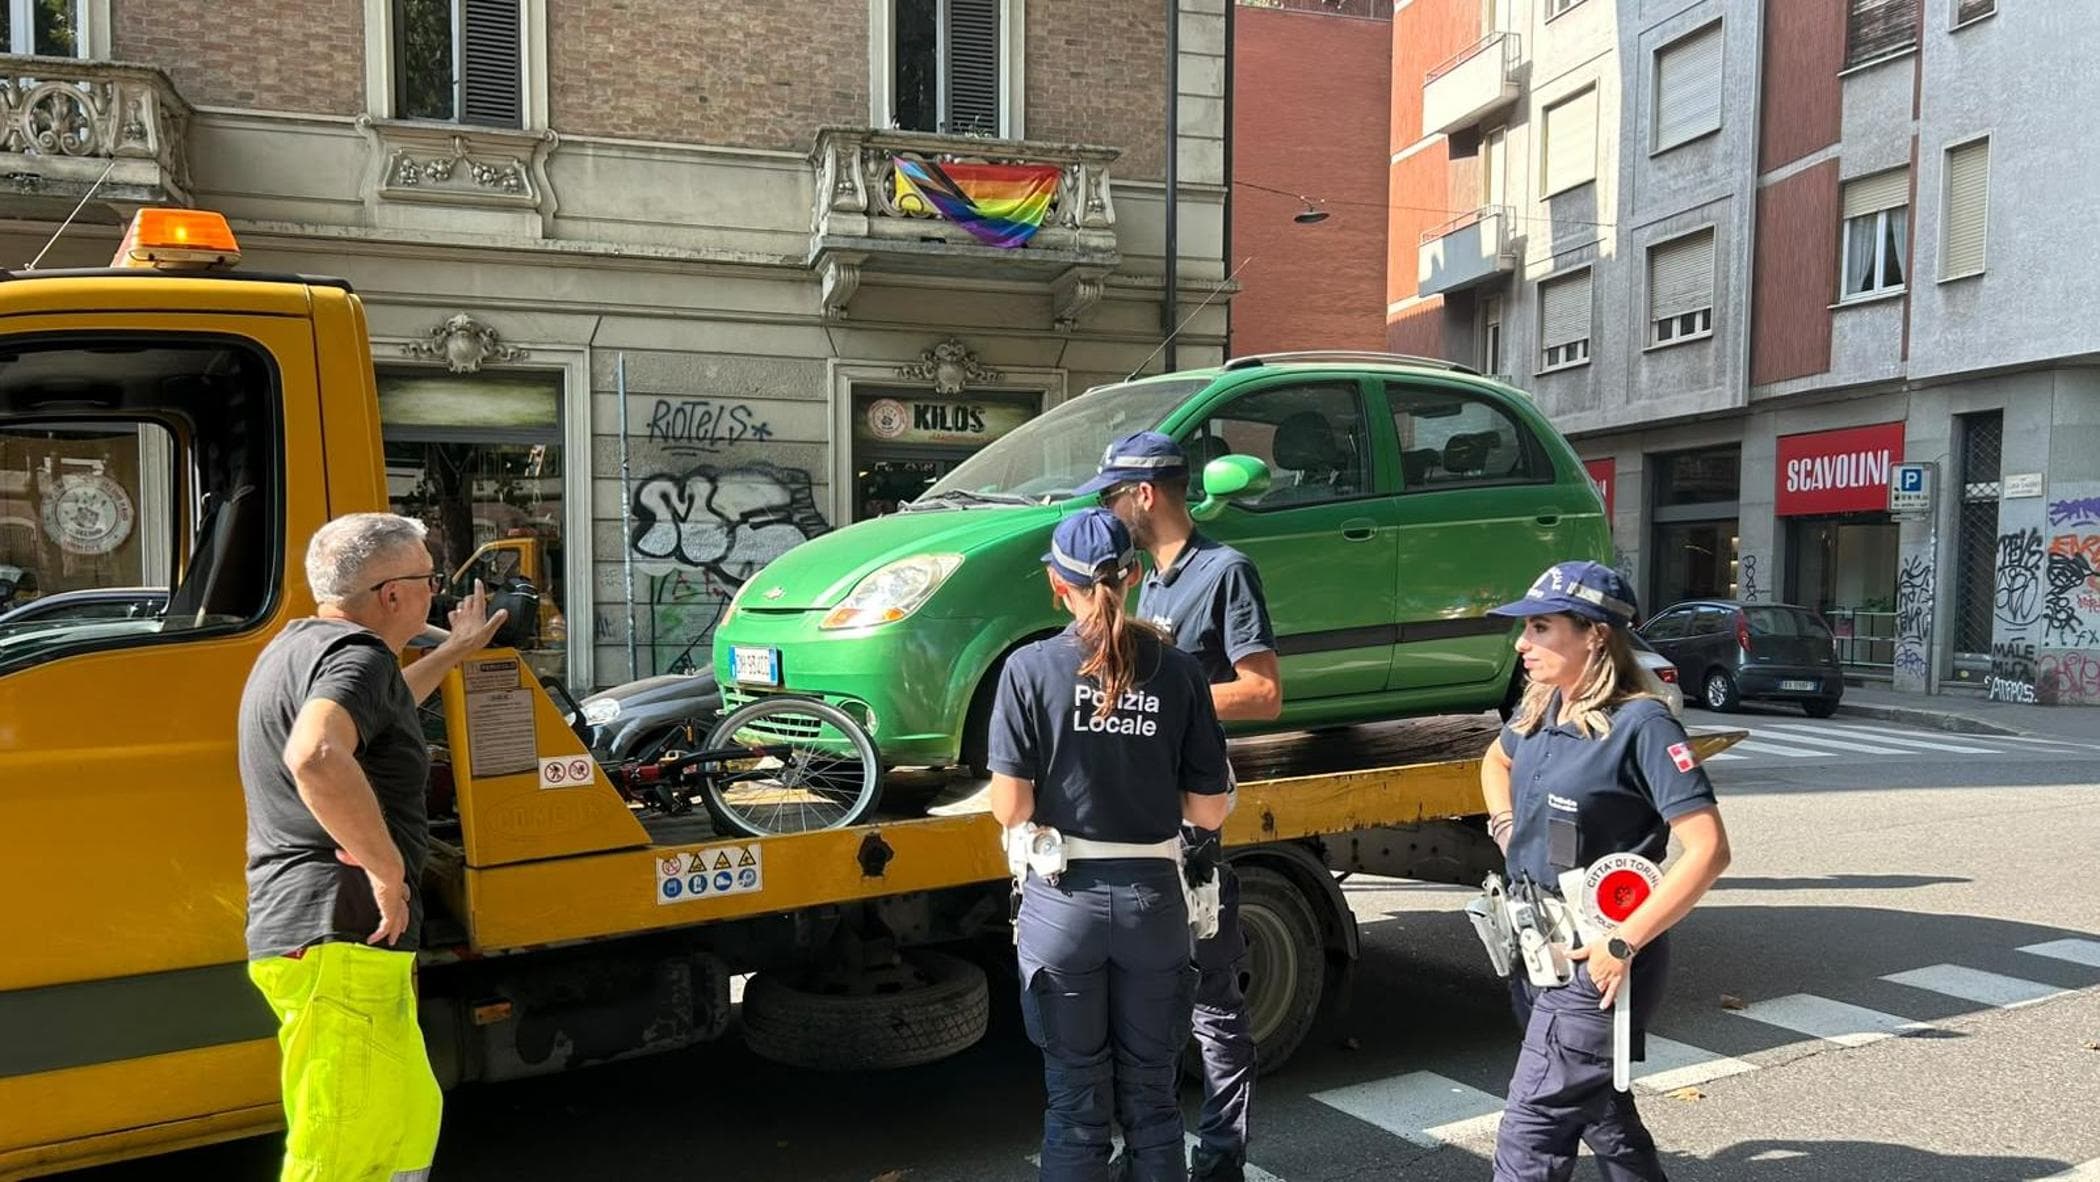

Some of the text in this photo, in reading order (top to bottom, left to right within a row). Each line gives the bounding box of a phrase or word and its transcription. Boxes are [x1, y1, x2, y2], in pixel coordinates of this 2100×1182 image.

[913, 404, 985, 433] KILOS
[1787, 449, 1889, 492] SCAVOLINI
[1905, 471, 1918, 489] P
[1075, 684, 1159, 713] Poizia
[1074, 714, 1157, 737] Locale
[1615, 859, 1627, 867] DI
